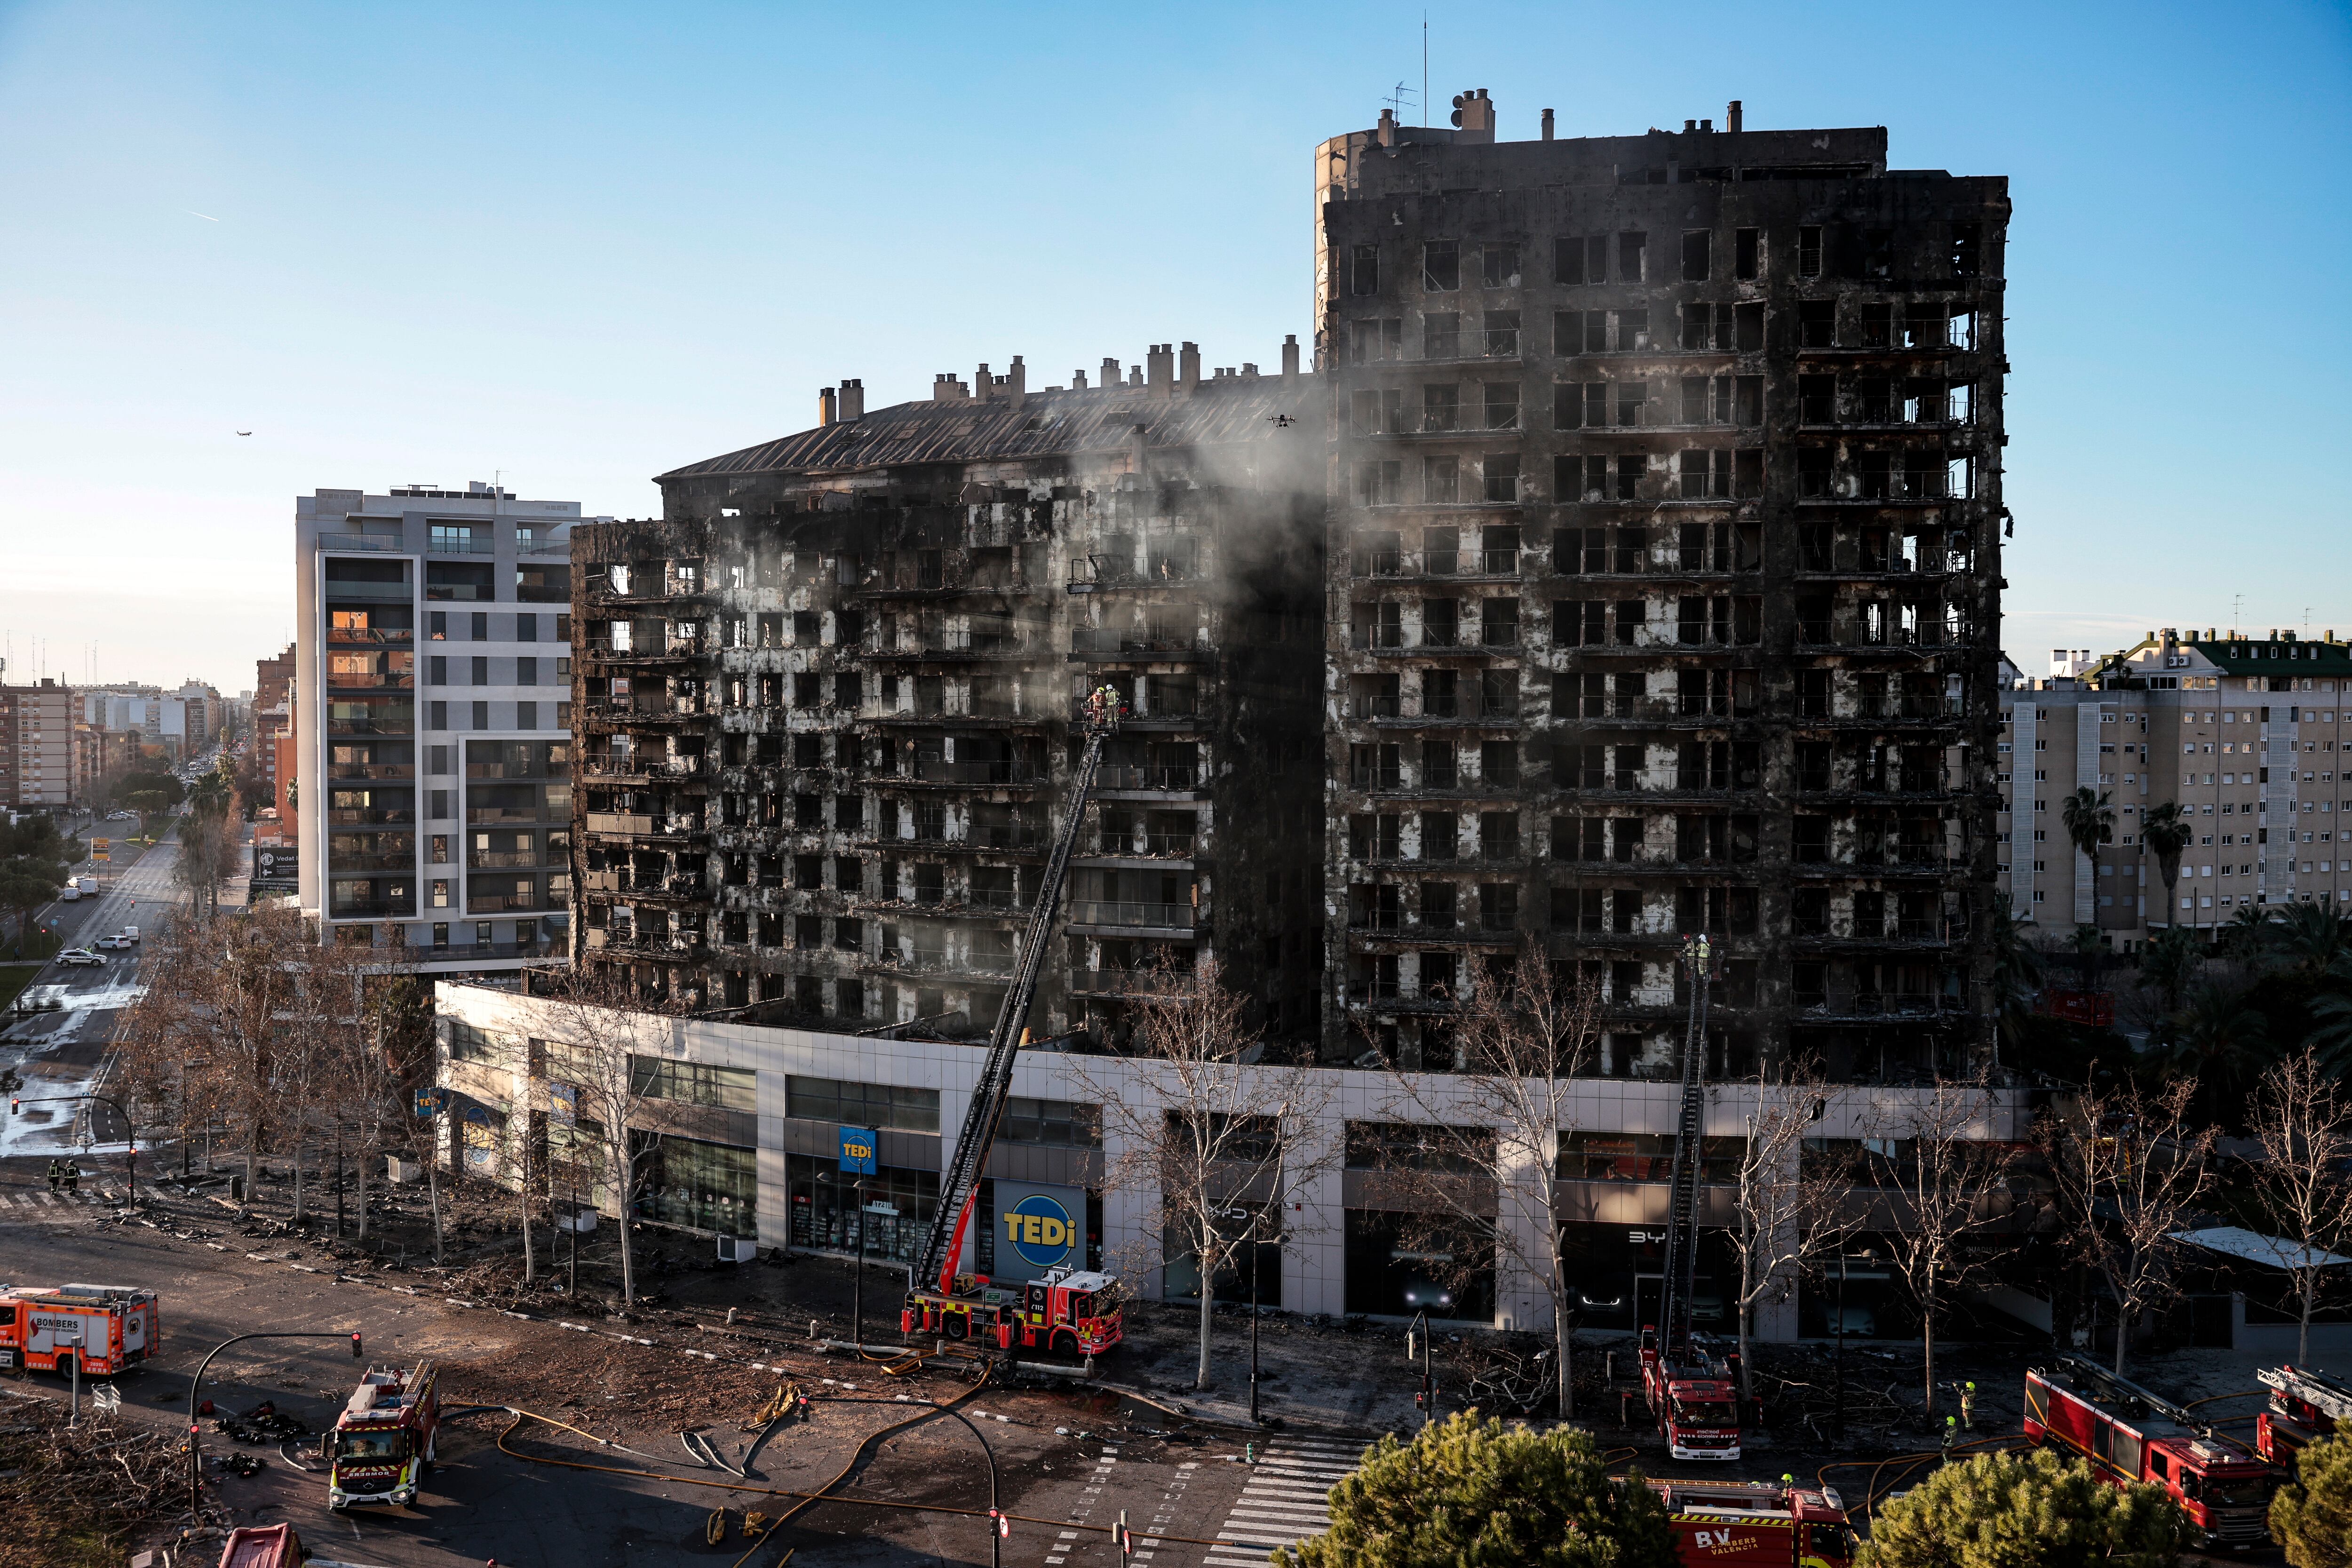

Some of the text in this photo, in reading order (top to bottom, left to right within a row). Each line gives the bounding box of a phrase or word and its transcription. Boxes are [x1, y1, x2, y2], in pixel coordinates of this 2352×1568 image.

[262, 854, 272, 865] MG
[843, 1143, 872, 1159] TEDi
[1003, 1212, 1076, 1248] TEDi
[37, 1318, 78, 1329] BOMBERS
[1694, 1528, 1730, 1548] BV
[1711, 1537, 1756, 1549] BOMBERS
[1711, 1543, 1758, 1555] VALENCIA
